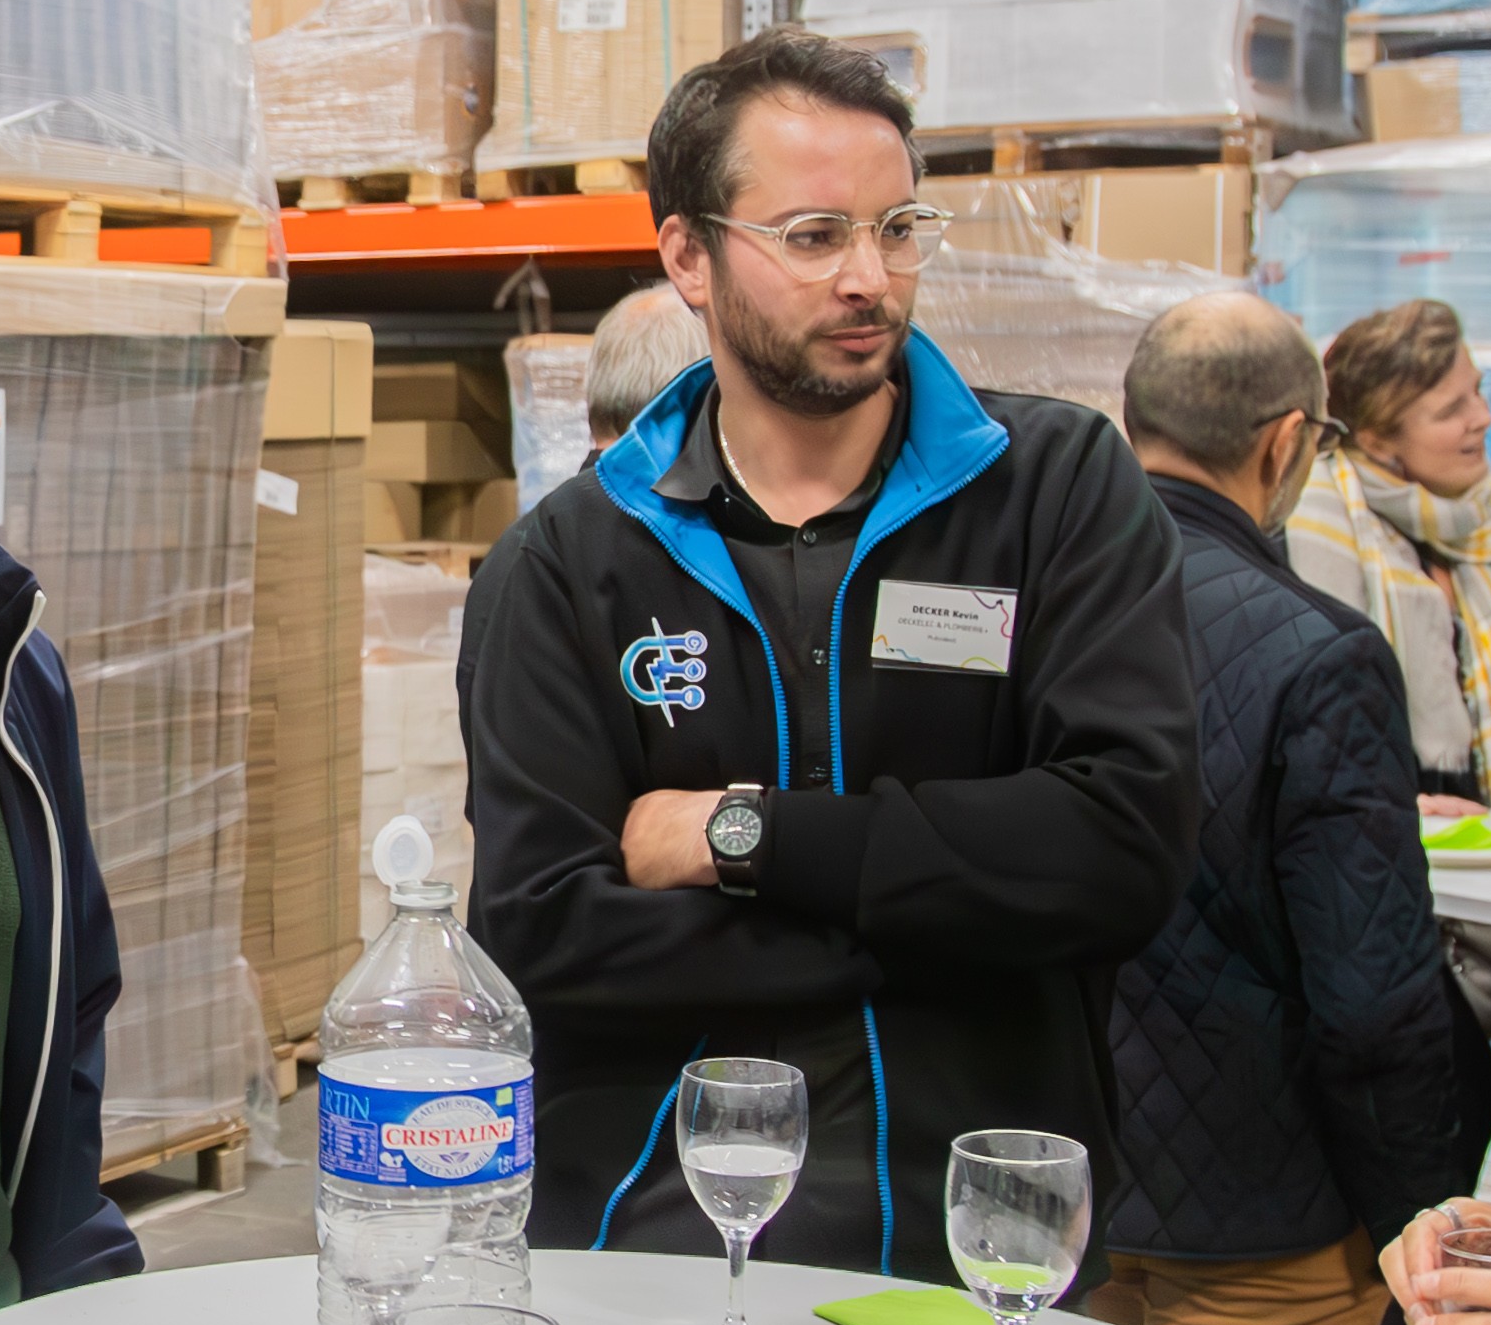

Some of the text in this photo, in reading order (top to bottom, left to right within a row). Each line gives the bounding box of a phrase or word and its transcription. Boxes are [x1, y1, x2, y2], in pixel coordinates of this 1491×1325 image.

[912, 605, 979, 620] DECKER Kevin
[321, 1087, 370, 1121] RTIN
[412, 1105, 435, 1124] EAU
[385, 1121, 512, 1147] CRISTALINE
